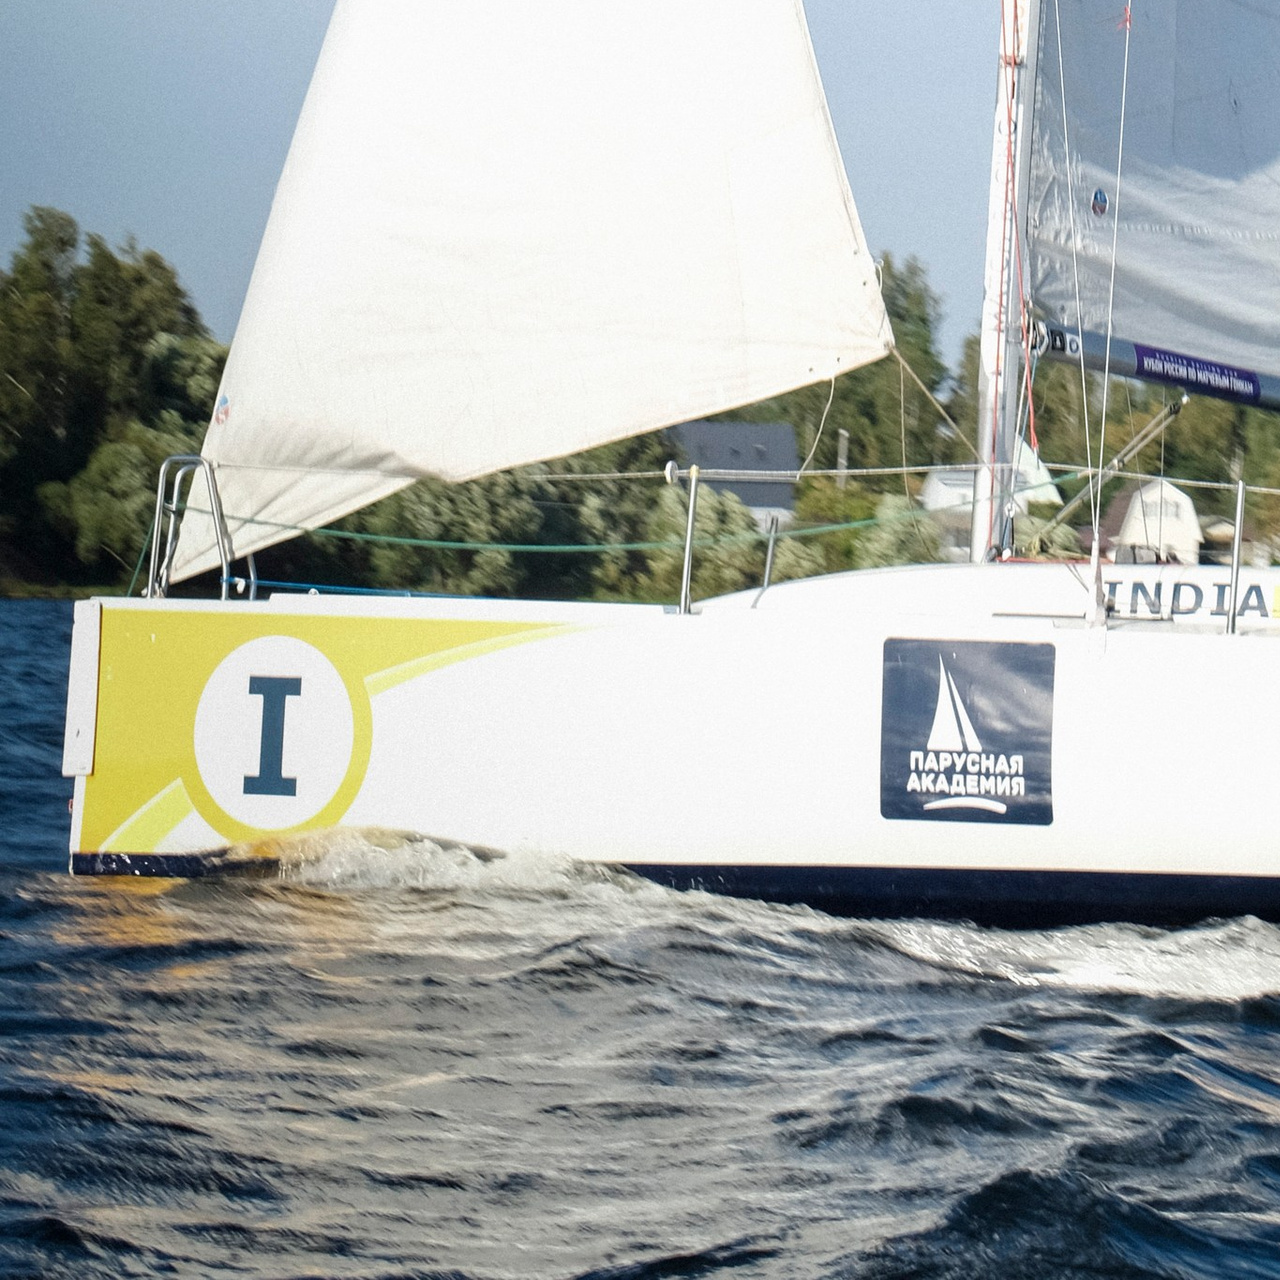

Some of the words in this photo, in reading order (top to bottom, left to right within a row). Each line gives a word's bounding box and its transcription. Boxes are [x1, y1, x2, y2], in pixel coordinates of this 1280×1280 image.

[1103, 580, 1270, 618] INDIA
[243, 675, 301, 796] I
[909, 750, 1024, 775] ПАРУСНАЯ
[906, 772, 1026, 797] АКАДЕМИЯ
